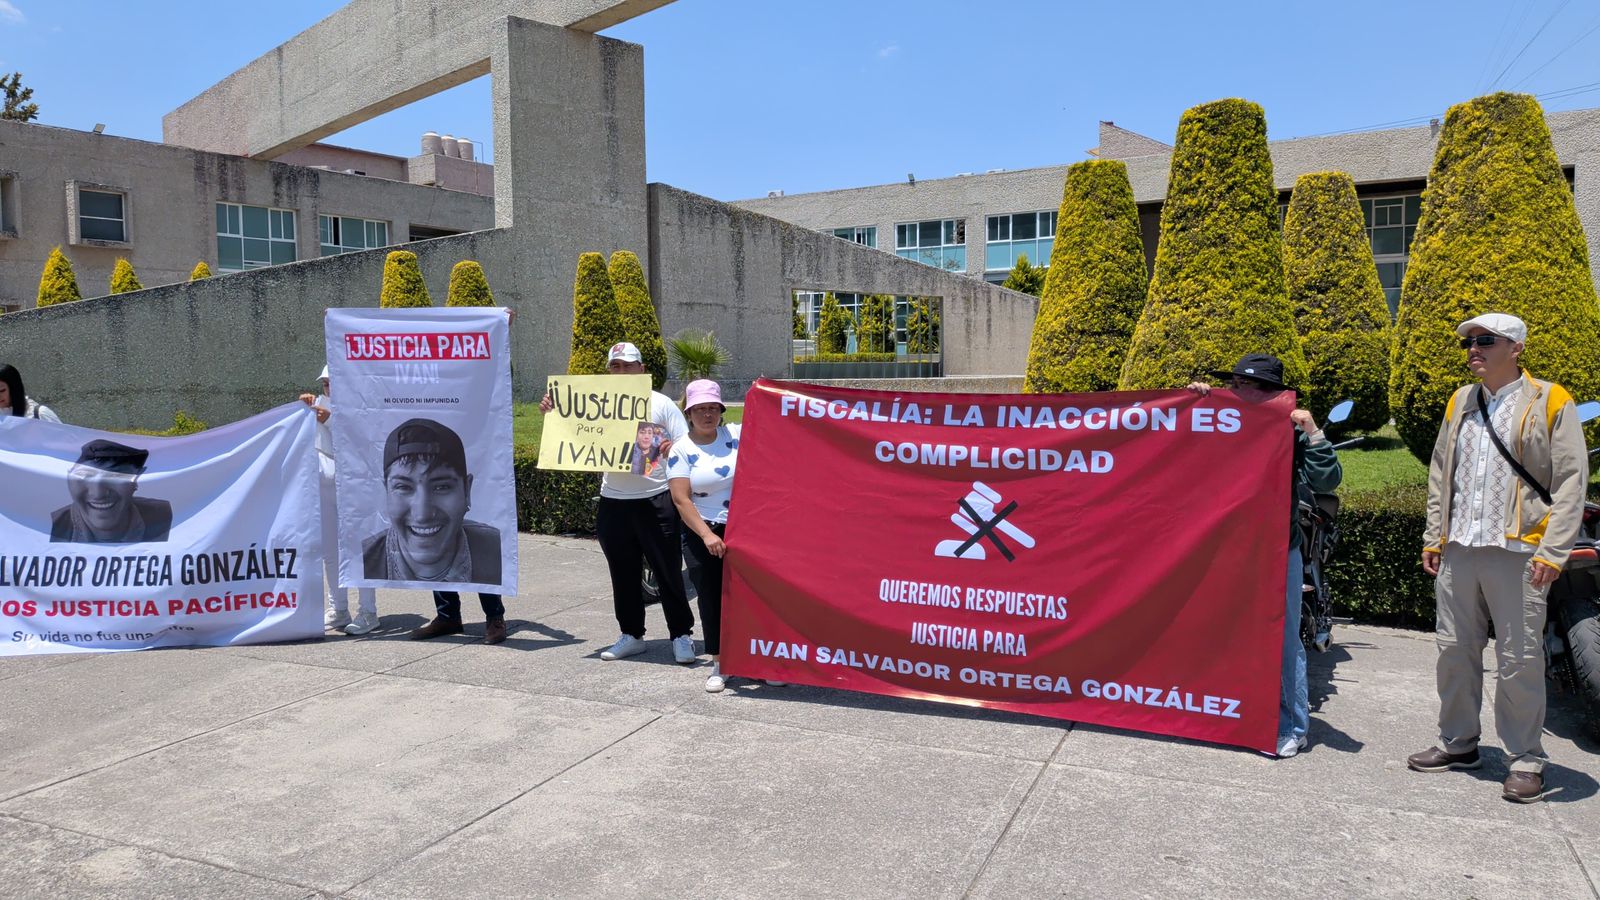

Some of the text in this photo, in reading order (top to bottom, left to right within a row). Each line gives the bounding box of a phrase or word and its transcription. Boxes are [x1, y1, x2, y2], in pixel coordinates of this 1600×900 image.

[346, 335, 489, 358] ¡JUSTICIA PARA
[395, 364, 439, 385] IVAN!
[780, 396, 1242, 433] FISCALÍA: LA INACCIÓN ES
[875, 441, 1114, 474] COMPLICIDAD
[91, 555, 173, 586] ORTEGA
[181, 543, 297, 585] GONZÁLEZ
[0, 592, 297, 617] OS JUSTICIA PACÍFICA!
[879, 578, 1068, 620] QUEREMOS RESPUESTAS
[40, 631, 70, 642] vida
[75, 633, 93, 642] no
[97, 631, 121, 641] fue
[910, 621, 1027, 657] JUSTICIA PARA
[750, 638, 1241, 719] IVAN SALVADOR ORTEGA GONZÁLEZ
